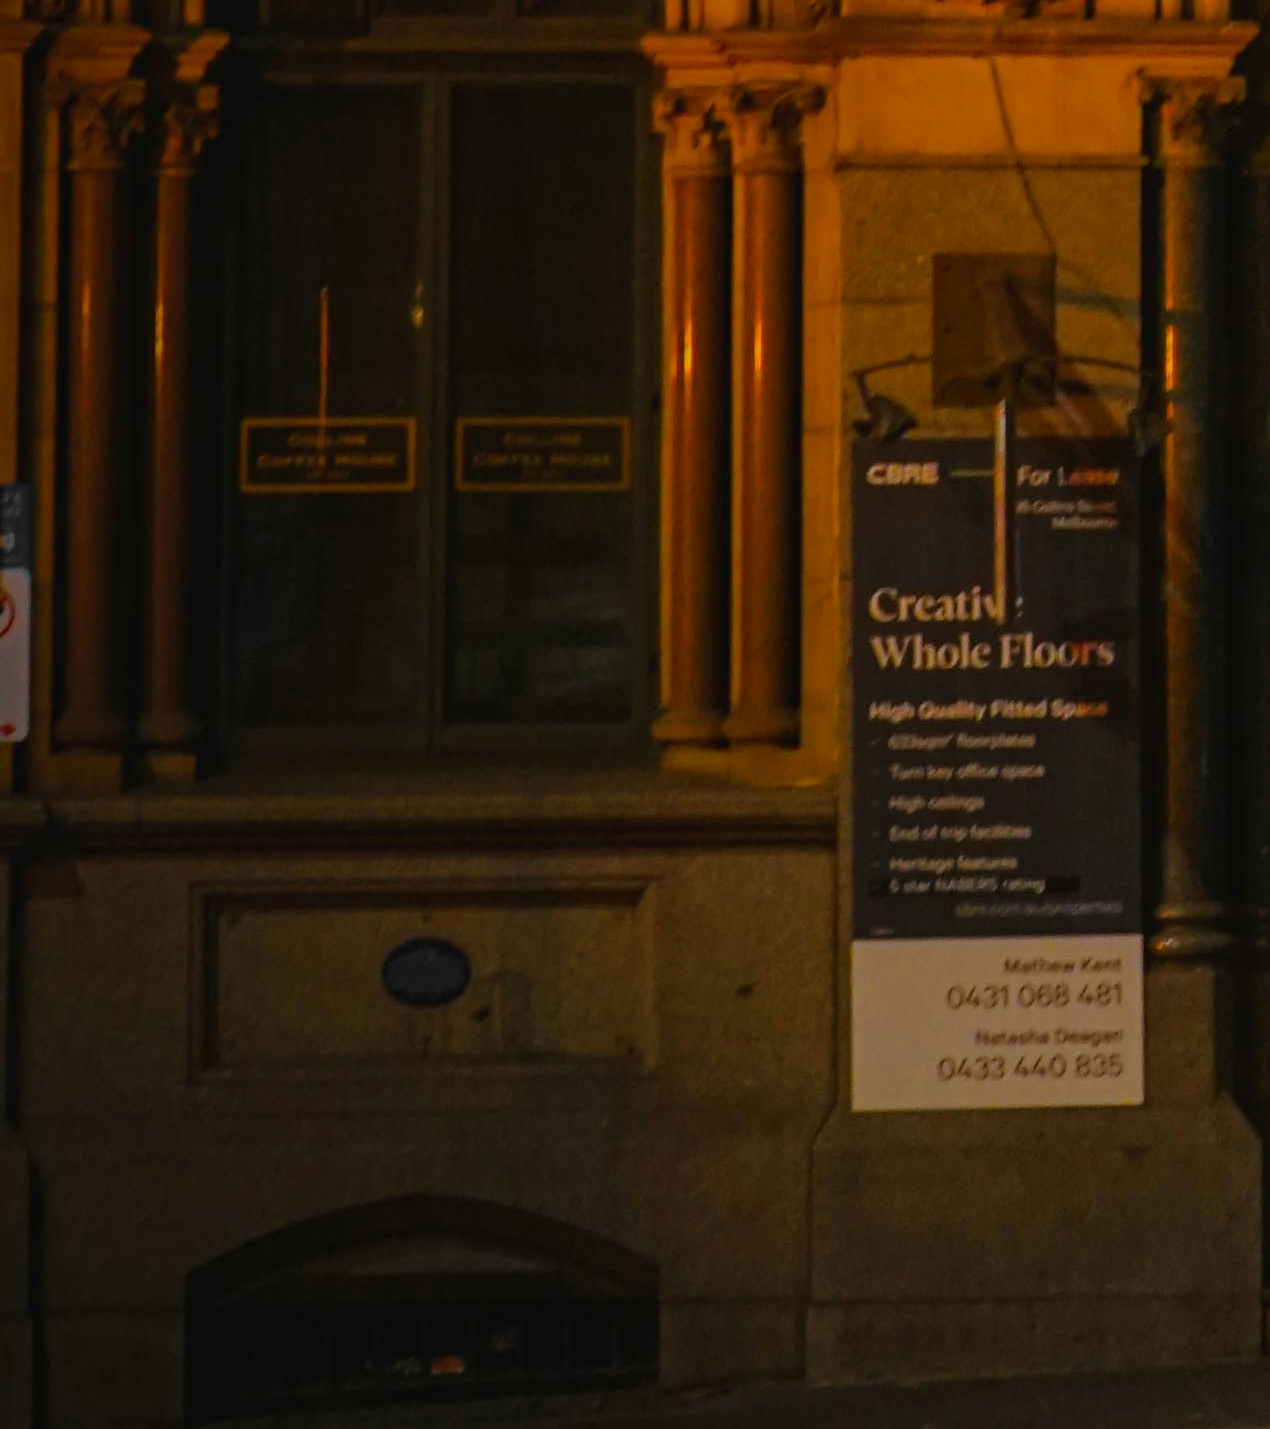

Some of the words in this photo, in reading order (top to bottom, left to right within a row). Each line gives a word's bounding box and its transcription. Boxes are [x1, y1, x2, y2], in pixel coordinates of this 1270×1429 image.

[865, 461, 940, 486] CBRE
[1016, 464, 1052, 487] For
[868, 631, 993, 671] Whole
[999, 630, 1117, 670] Floors
[868, 699, 916, 725] High
[917, 699, 987, 722] Quality
[988, 697, 1048, 720] Fitted
[889, 762, 925, 781] Turn
[955, 760, 999, 781] office
[888, 795, 926, 816] High
[927, 795, 985, 815] ceilings
[888, 823, 920, 843] End
[920, 824, 939, 841] of
[939, 824, 968, 844] trip
[969, 823, 1033, 841] facilities
[888, 855, 955, 875] Heritage
[956, 854, 1019, 872] features
[1001, 878, 1047, 895] rating
[1080, 957, 1124, 973] Kent
[946, 981, 1010, 1011] 0431
[1077, 981, 1124, 1006] 481
[974, 1028, 1050, 1046] Natasha
[937, 1053, 1006, 1081] 0433
[1013, 1053, 1068, 1080] 440
[1074, 1052, 1124, 1079] 835
